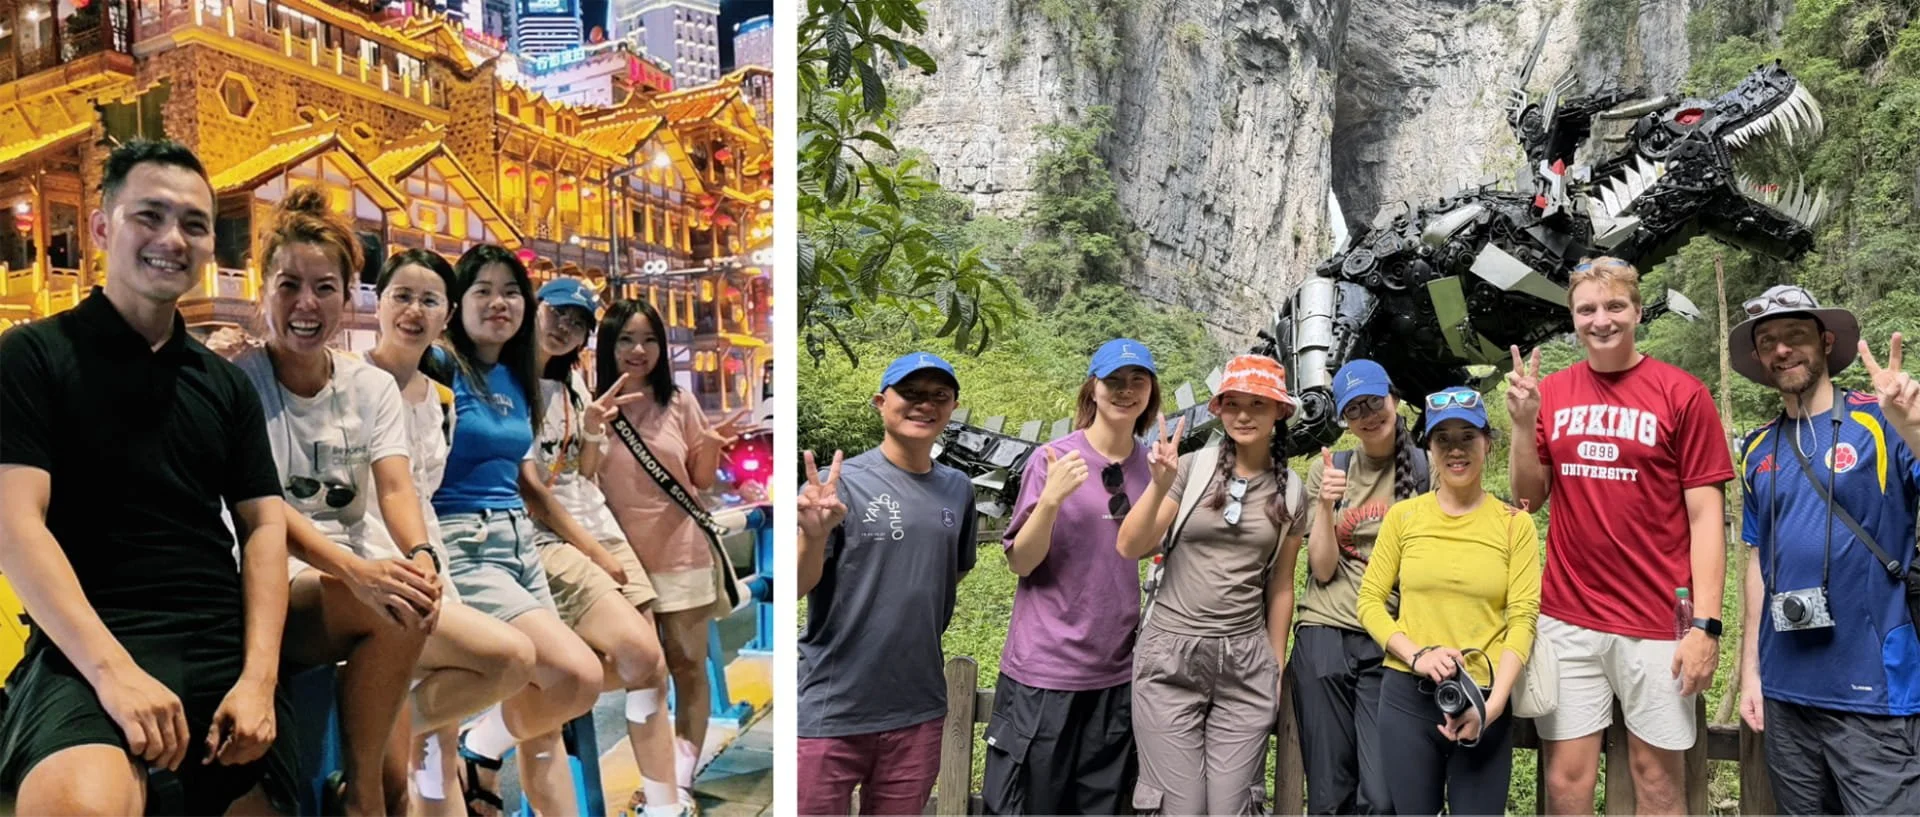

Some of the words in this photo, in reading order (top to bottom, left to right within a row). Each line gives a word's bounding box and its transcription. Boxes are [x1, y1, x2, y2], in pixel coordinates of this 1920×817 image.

[1551, 404, 1657, 447] PEKING
[615, 420, 670, 483] SONGMONT
[1561, 463, 1638, 481] UNIVERSITY
[1583, 443, 1614, 458] 1898
[862, 493, 890, 523] YANG
[888, 501, 904, 540] SHUO
